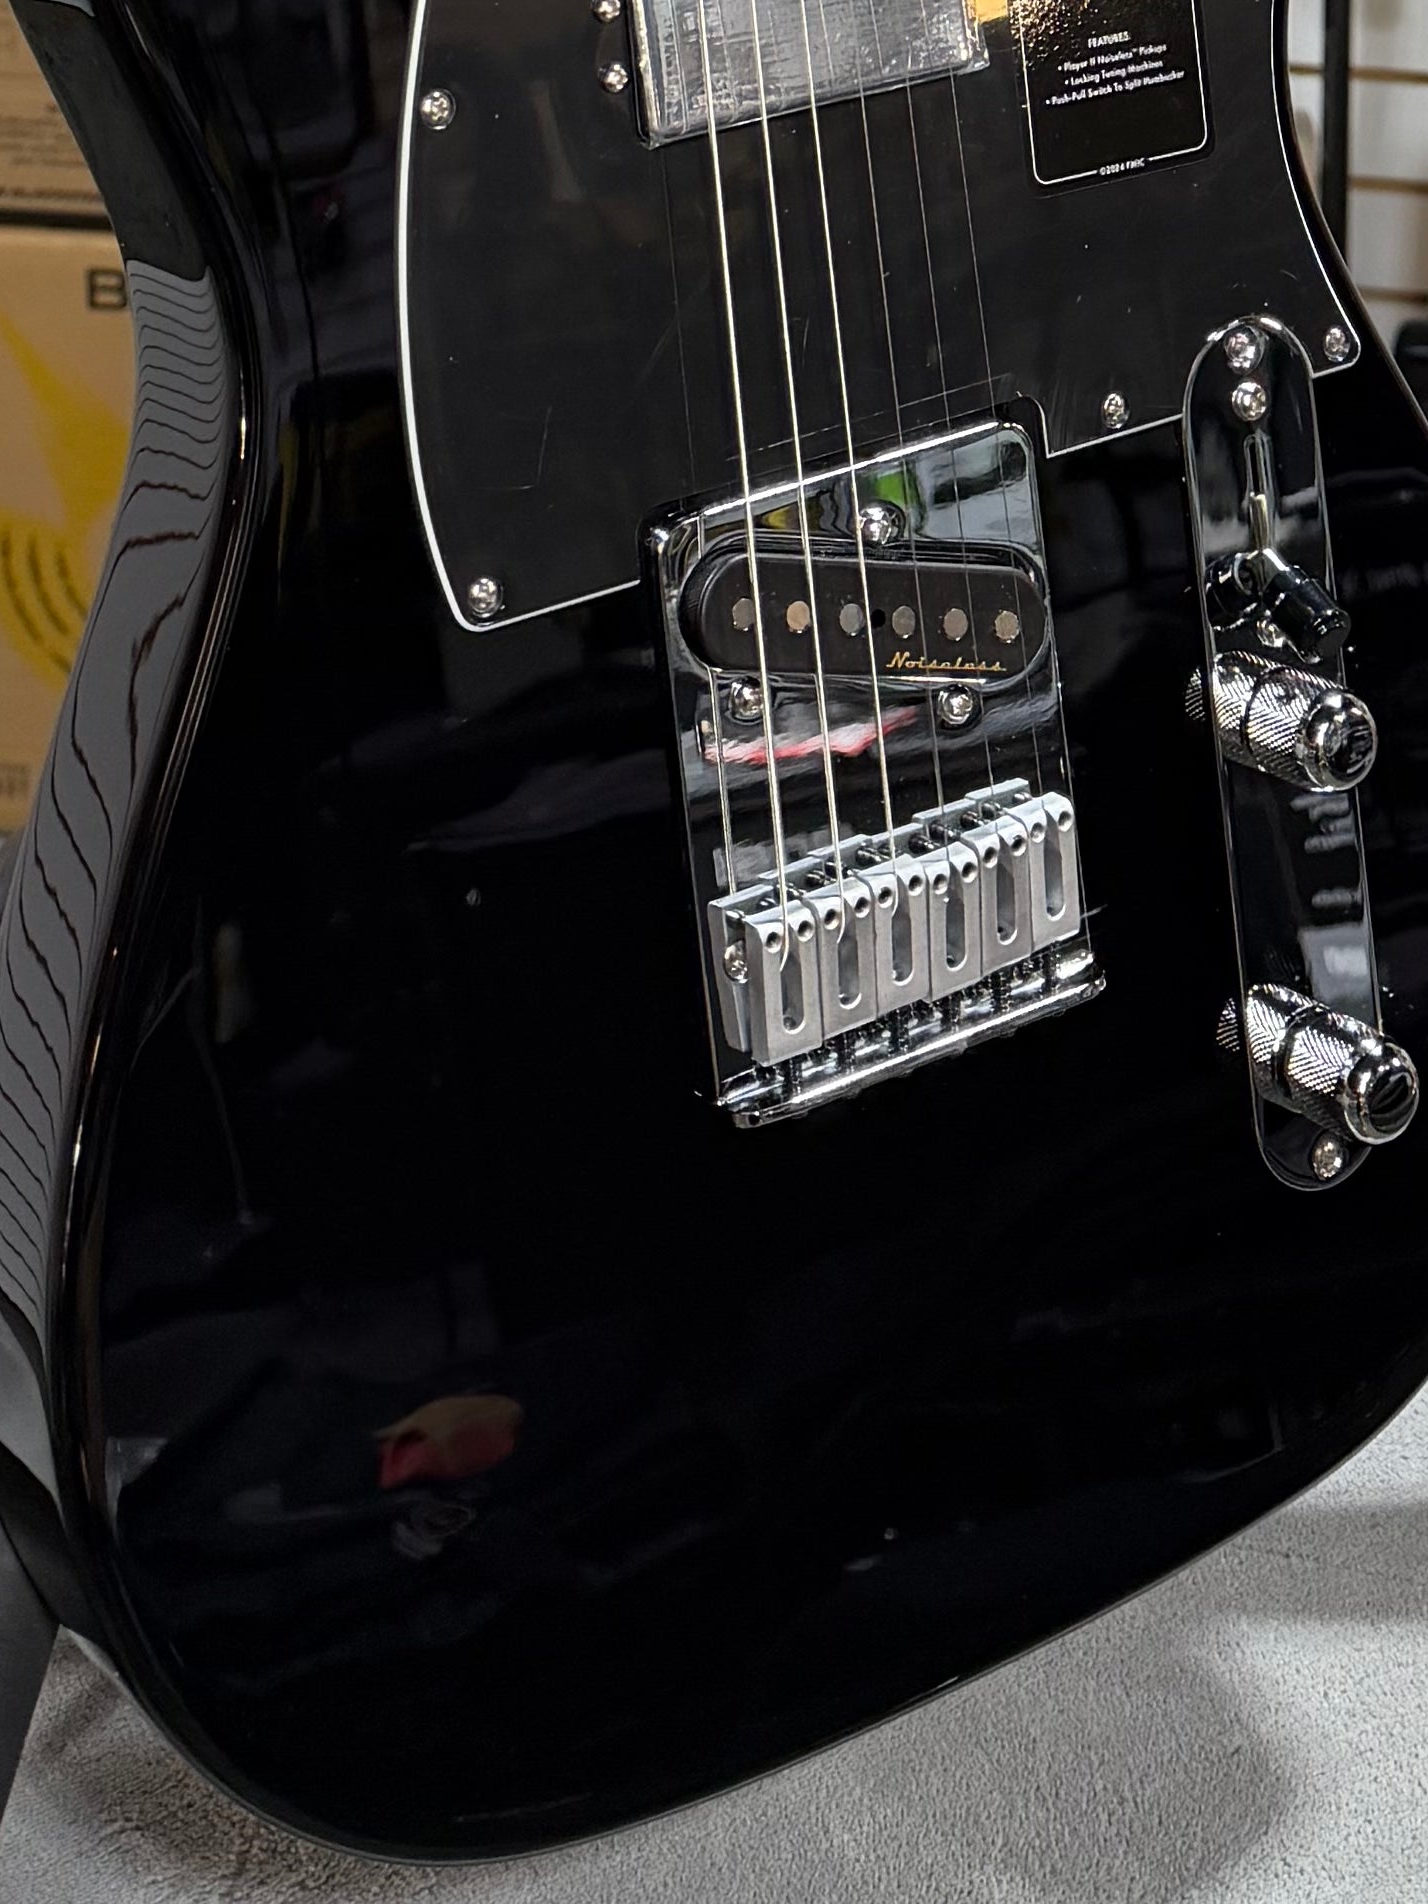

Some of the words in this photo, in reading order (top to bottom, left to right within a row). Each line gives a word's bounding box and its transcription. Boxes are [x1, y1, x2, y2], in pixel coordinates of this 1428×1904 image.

[1138, 44, 1168, 57] Pickups
[1070, 71, 1100, 86] Locking
[1101, 67, 1126, 81] Tuning
[1127, 60, 1164, 73] Machines
[1051, 89, 1087, 105] Push-Pull
[1087, 84, 1113, 98] Switch
[1113, 82, 1124, 92] To
[1124, 78, 1142, 91] Split
[885, 650, 1007, 672] Noiseless
